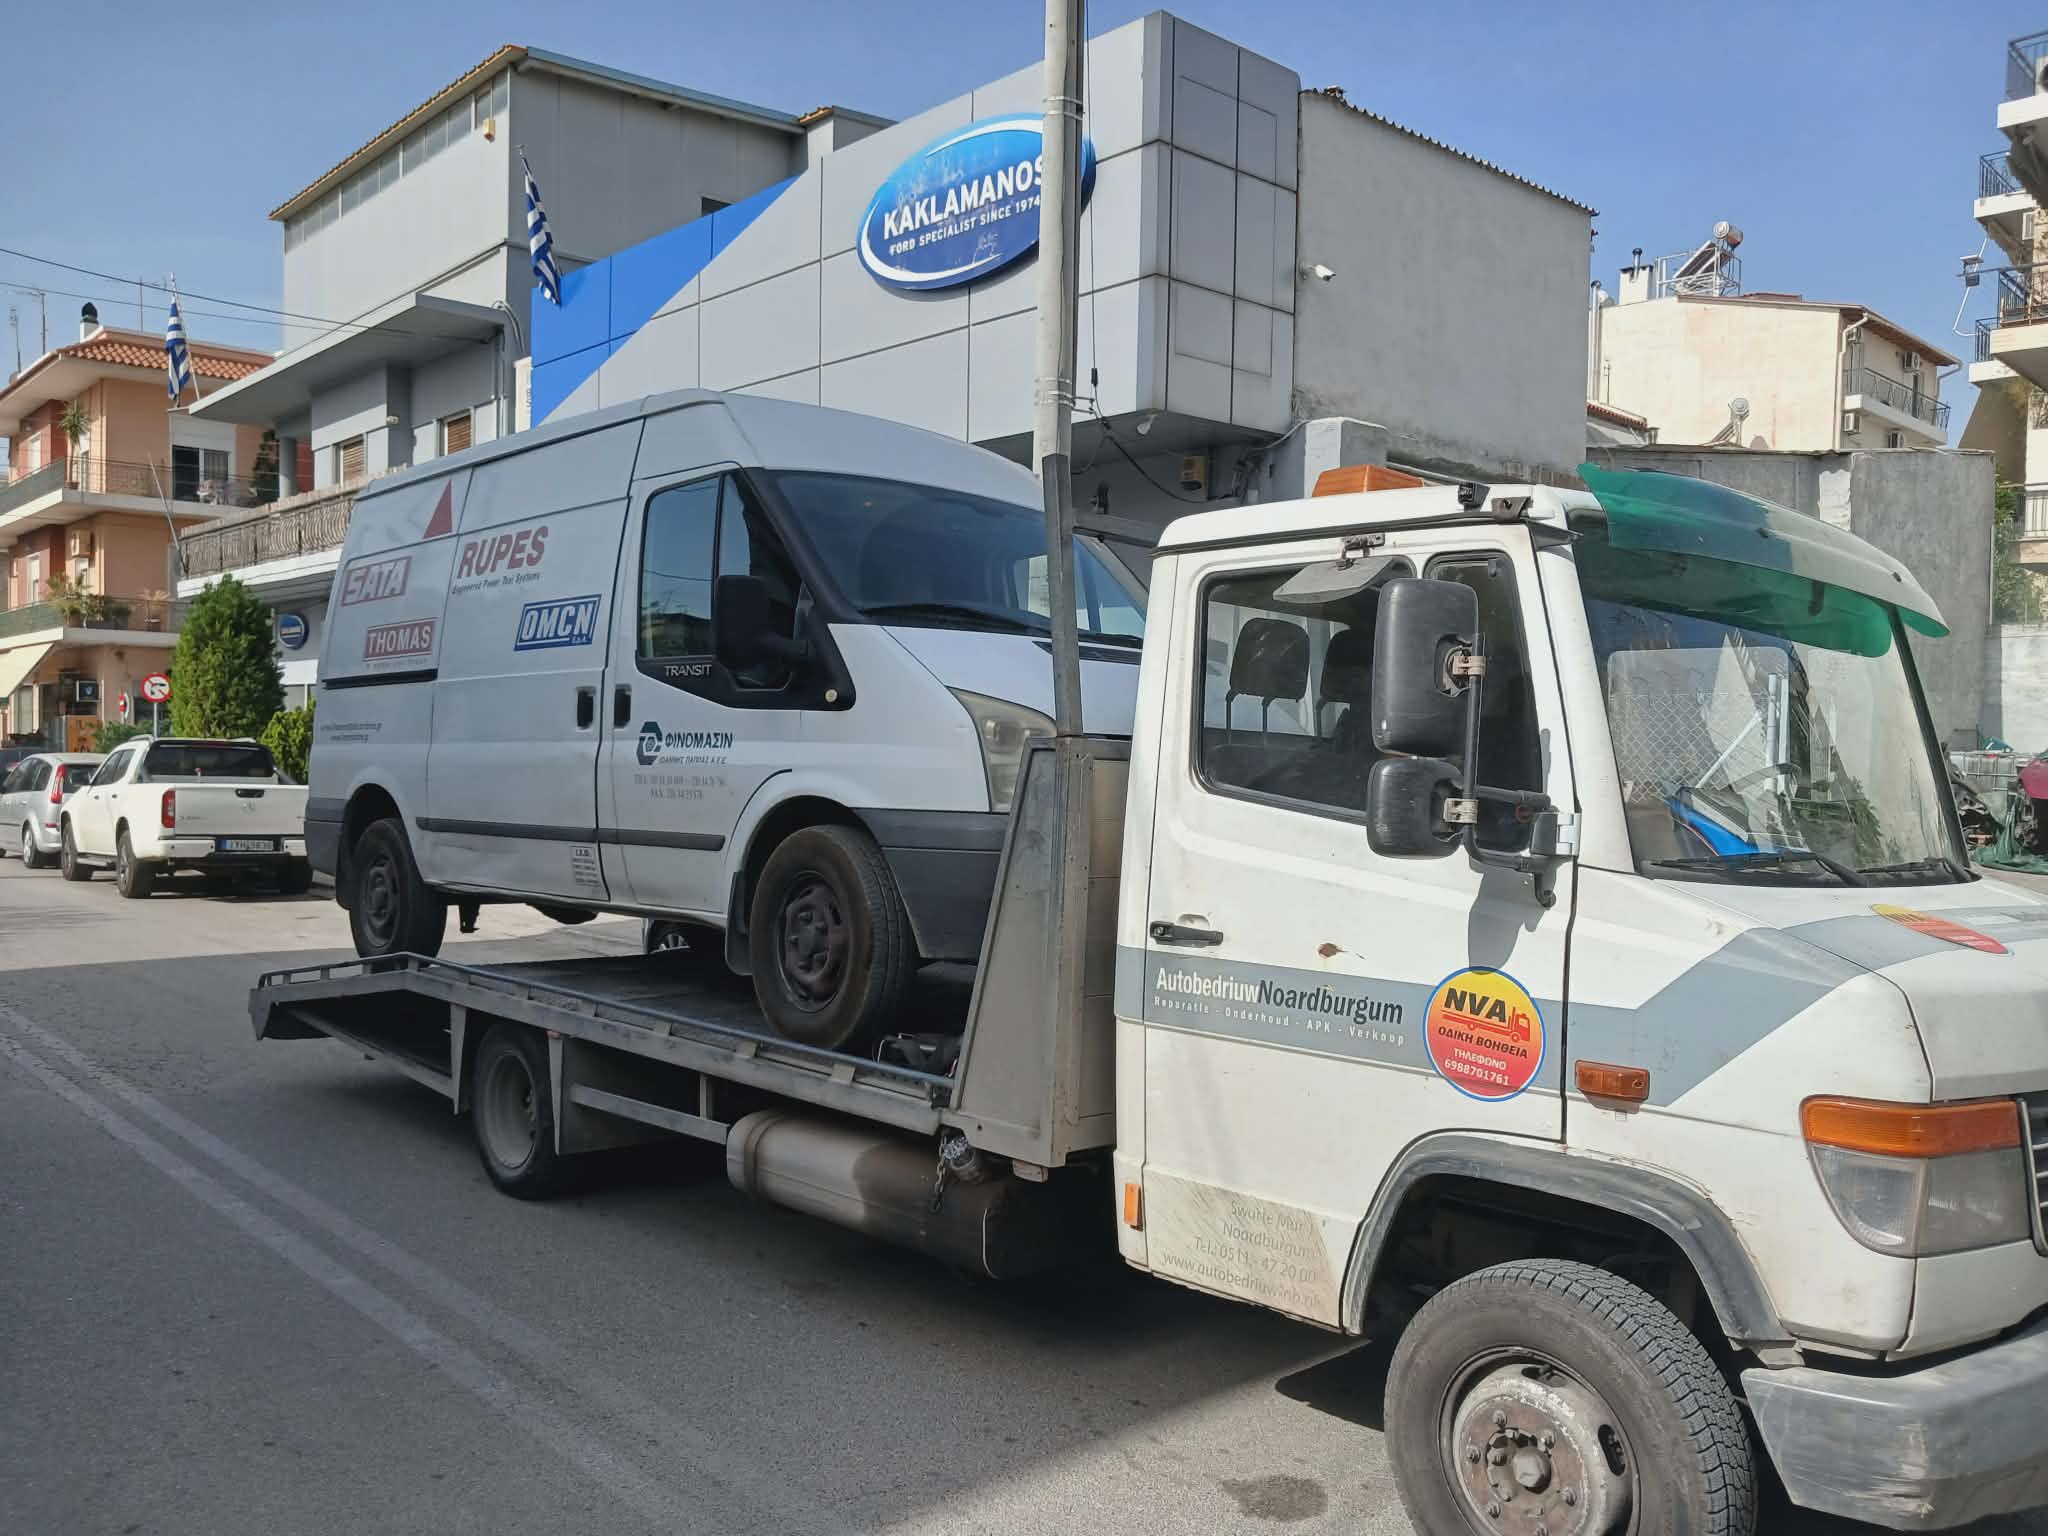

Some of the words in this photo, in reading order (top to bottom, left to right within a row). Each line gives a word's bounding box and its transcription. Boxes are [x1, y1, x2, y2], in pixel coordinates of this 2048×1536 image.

[889, 239, 915, 256] FORD
[919, 217, 976, 247] SPECIALIST
[980, 205, 1012, 226] SINCE
[1016, 195, 1041, 213] 1974
[457, 526, 548, 579] RUPES
[344, 560, 407, 603] SATA
[521, 603, 594, 640] OMCN
[368, 625, 431, 656] THOMAS
[664, 664, 712, 677] TRANSIT
[665, 732, 733, 748] ΦΙΝΟΜΑΣΙΝ
[1154, 995, 1209, 1015] Reparatie
[1225, 1007, 1289, 1026] Onderhoud
[1306, 1018, 1331, 1033] APK
[1349, 1025, 1405, 1046] Verkoop
[1257, 980, 1403, 1025] Noardburgum
[1444, 987, 1507, 1023] NVA
[1438, 1026, 1473, 1044] ΟΔΙΚΗ
[1476, 1037, 1528, 1059] ΒΟΗΘΕΙΑ
[1454, 1047, 1507, 1070] ΤΗΛΕΦΩΝΟ
[1444, 1058, 1509, 1086] 6988701761
